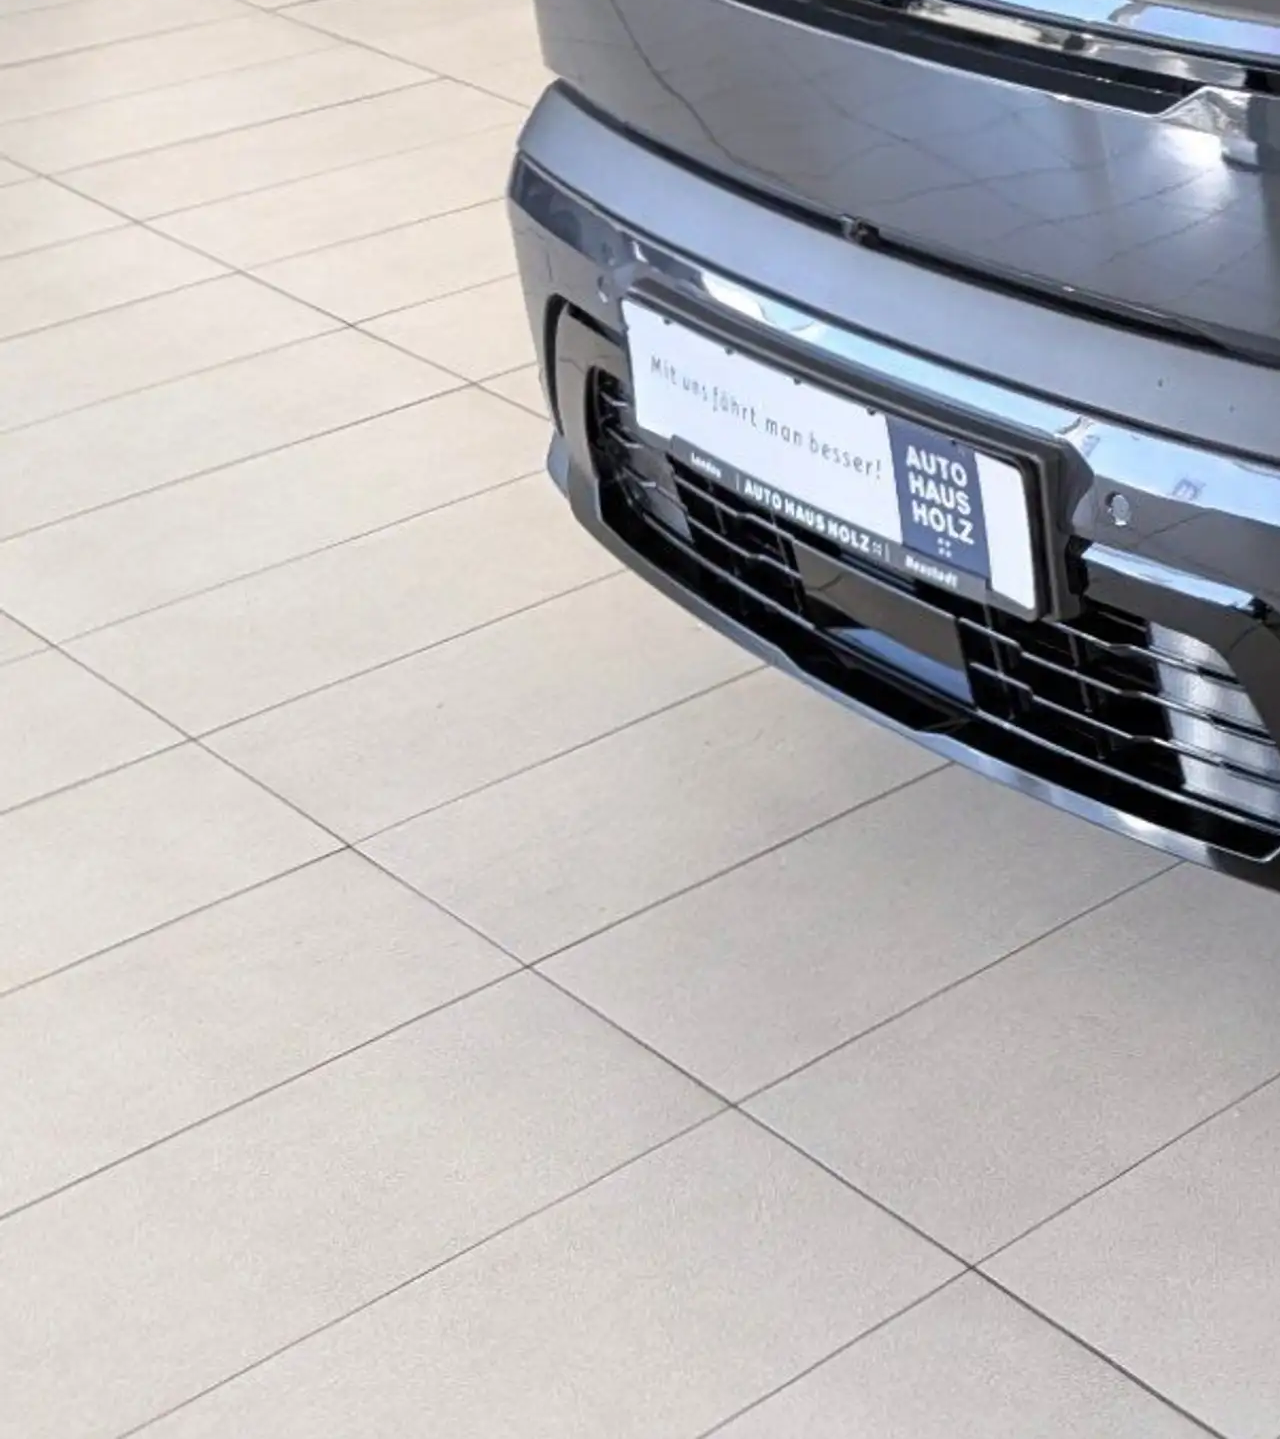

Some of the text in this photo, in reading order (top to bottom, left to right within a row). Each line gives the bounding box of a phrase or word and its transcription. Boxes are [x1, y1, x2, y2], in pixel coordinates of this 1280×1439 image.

[765, 416, 802, 446] man
[809, 432, 881, 480] besser!
[906, 444, 968, 488] AUTO
[744, 478, 782, 510] AUTO
[784, 498, 825, 532] HAUS
[827, 520, 871, 553] HOLZ
[908, 470, 972, 516] HAUS
[911, 499, 976, 546] HOLZ
